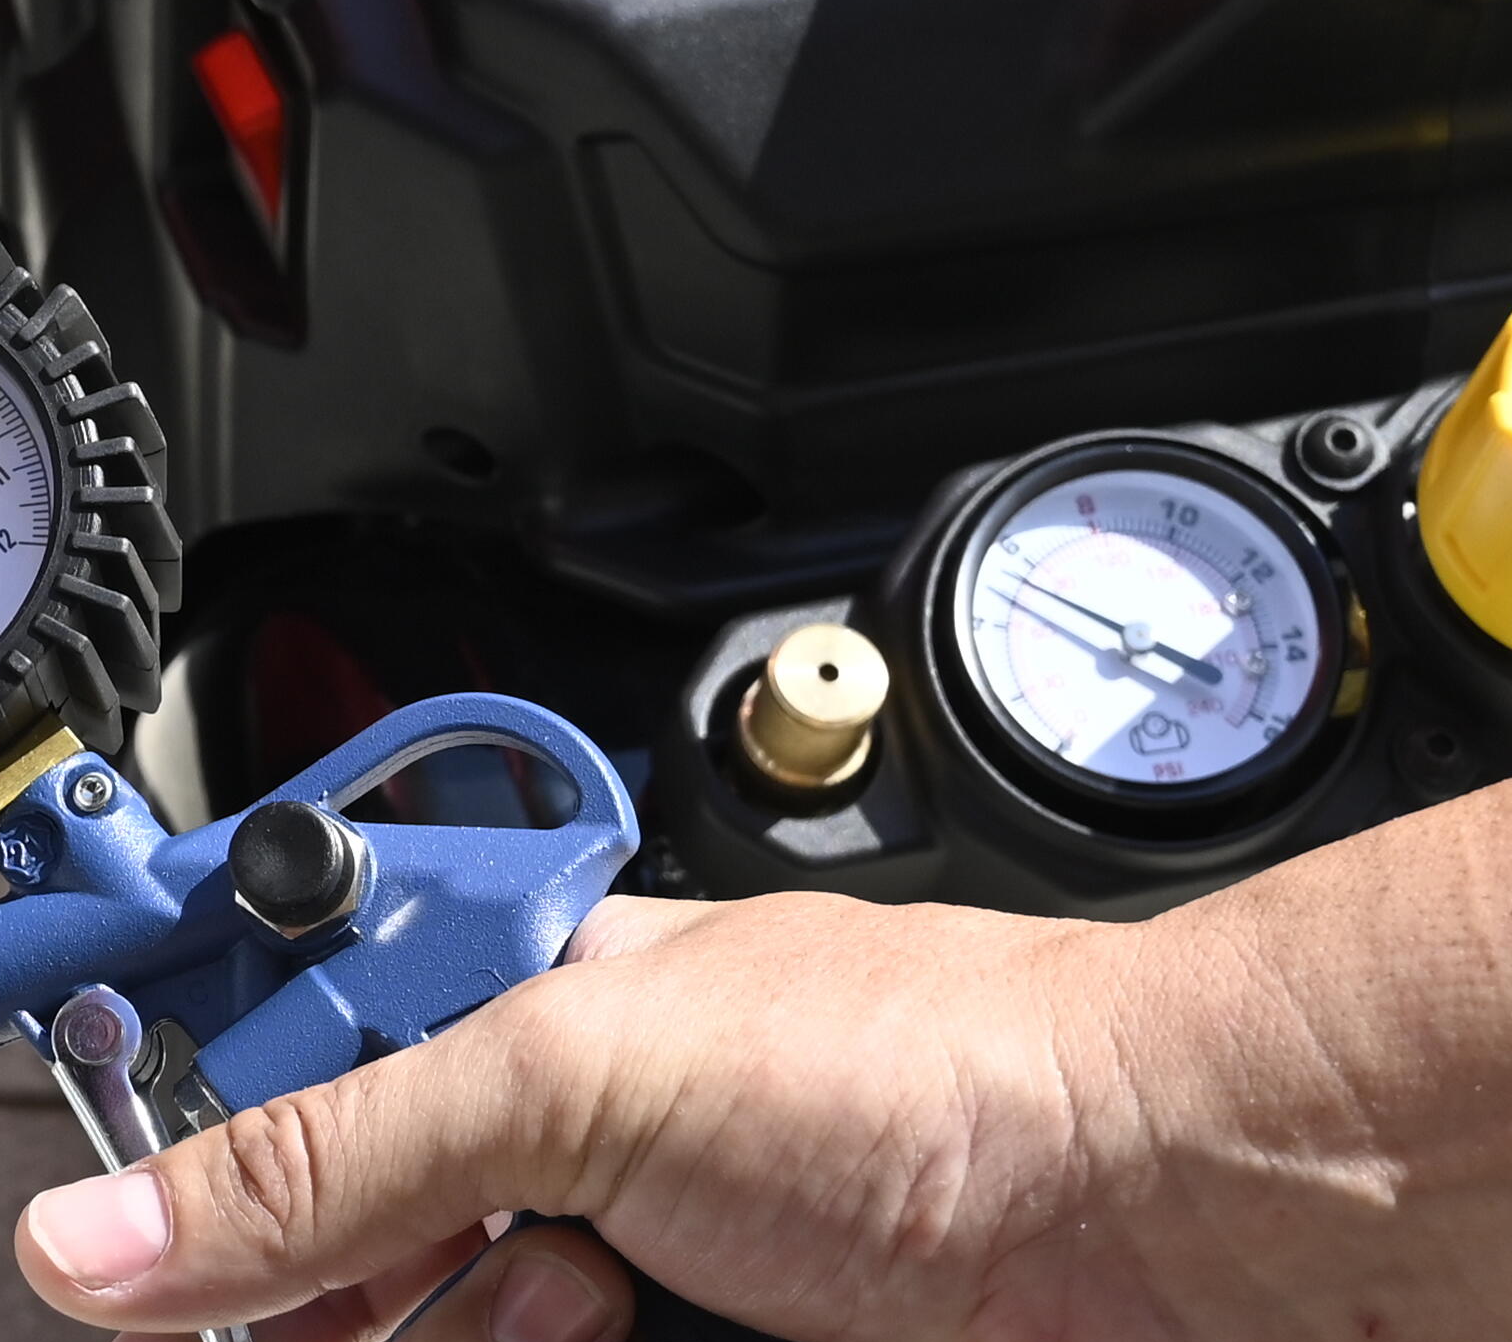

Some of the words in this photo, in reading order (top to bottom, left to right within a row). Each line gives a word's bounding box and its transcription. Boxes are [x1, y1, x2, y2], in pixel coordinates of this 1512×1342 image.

[1160, 498, 1200, 527] 10
[1241, 546, 1276, 584] 12
[1281, 625, 1309, 663] 14
